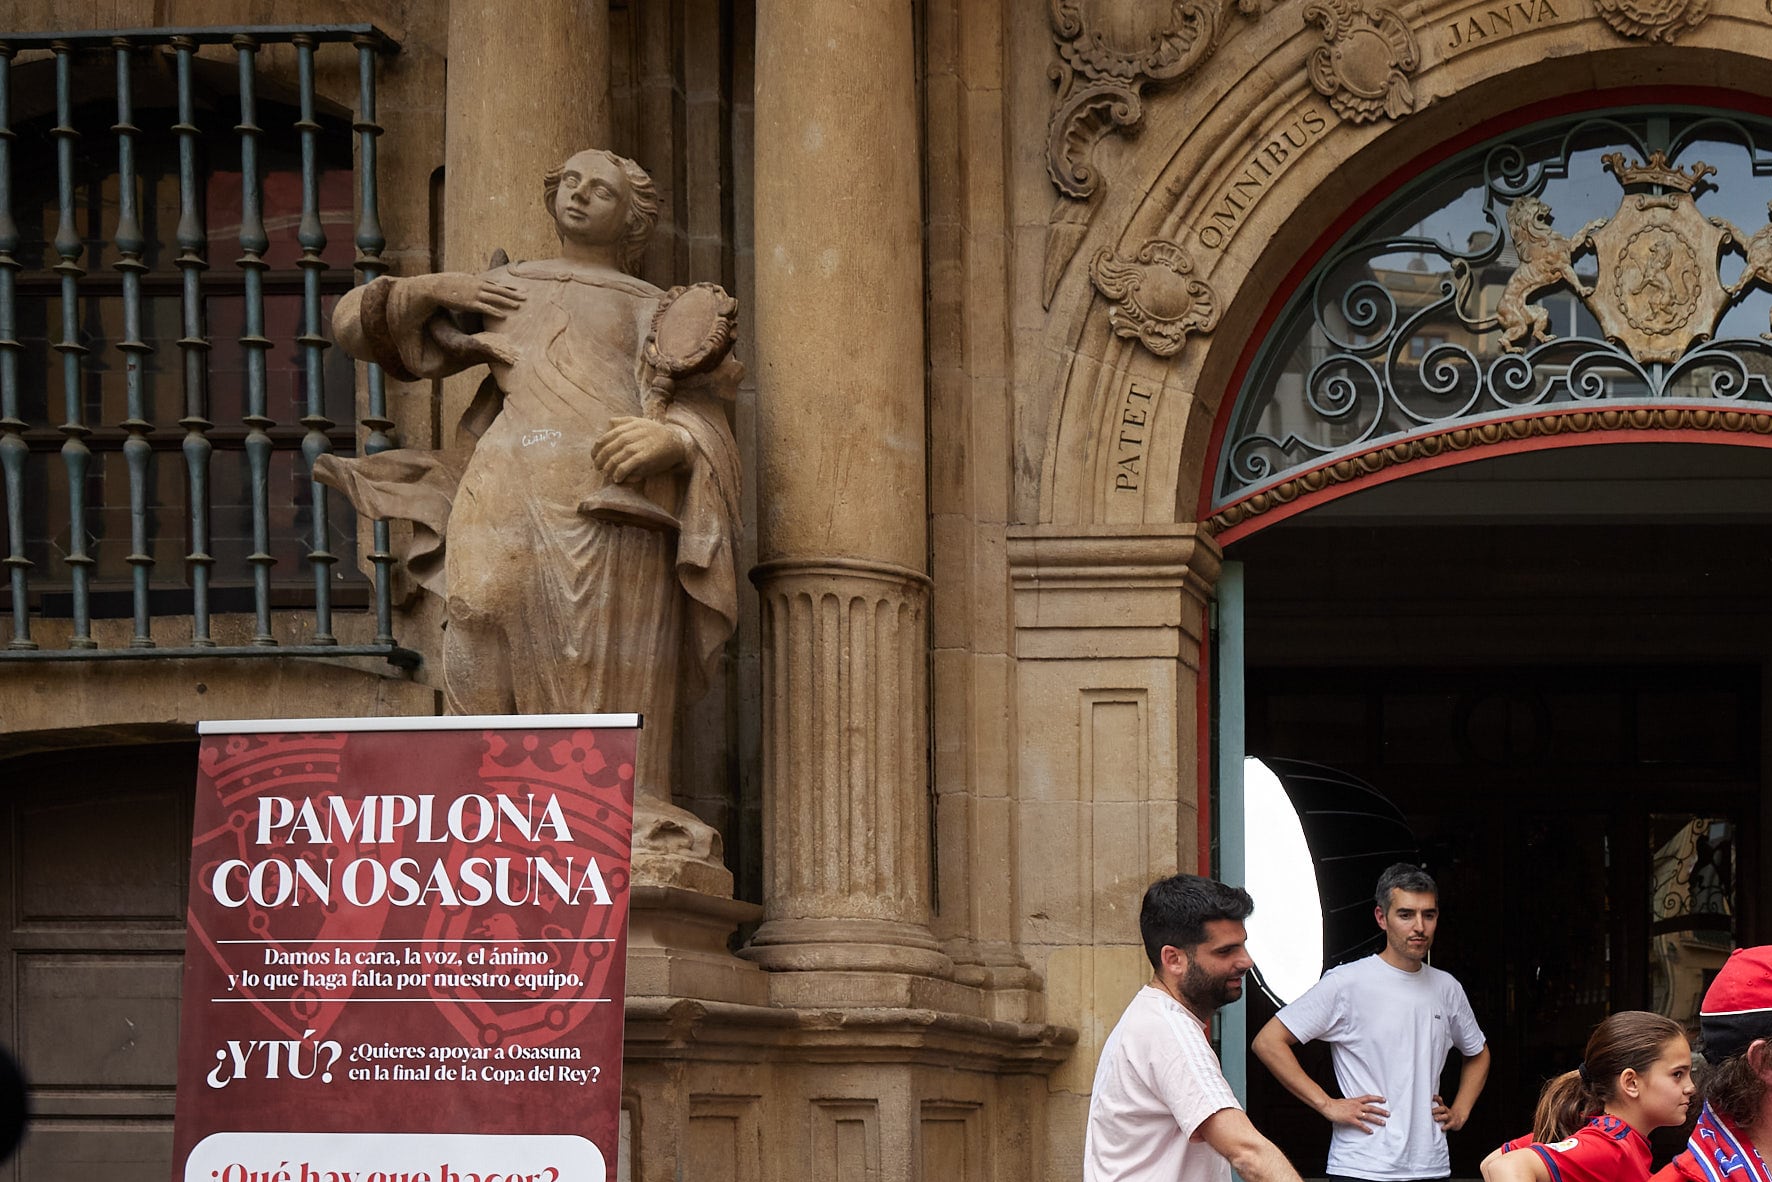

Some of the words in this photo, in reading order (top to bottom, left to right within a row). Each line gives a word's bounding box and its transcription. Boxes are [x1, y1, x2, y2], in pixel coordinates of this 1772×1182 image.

[1448, 0, 1560, 48] JANVA
[1200, 109, 1326, 249] OMNIBUS
[1115, 383, 1152, 493] PATET
[255, 793, 574, 844] PAMPLONA
[212, 858, 334, 908] CON
[342, 856, 613, 907] OSASUNA
[227, 974, 239, 991] y
[242, 969, 260, 988] lo
[263, 973, 299, 992] que
[302, 970, 347, 992] haga
[351, 969, 393, 988] falta
[397, 973, 430, 992] por
[434, 971, 510, 988] nuestro
[514, 970, 584, 992] equipo.
[264, 947, 330, 966] Damos
[335, 947, 351, 965] la
[355, 951, 400, 968] cara,
[404, 947, 422, 965] la
[424, 952, 463, 967] voz,
[467, 947, 485, 965] el
[489, 947, 548, 965] ánimo
[348, 1069, 371, 1082] en
[374, 1065, 390, 1082] la
[393, 1065, 431, 1082] final
[433, 1065, 457, 1082] de
[461, 1065, 477, 1082] la
[480, 1067, 525, 1084] Copa
[527, 1065, 556, 1082] del
[558, 1067, 601, 1084] Rey?
[349, 1043, 426, 1061] ¿Quieres
[428, 1047, 492, 1064] apoyar
[495, 1048, 505, 1059] a
[507, 1045, 581, 1060] Osasuna
